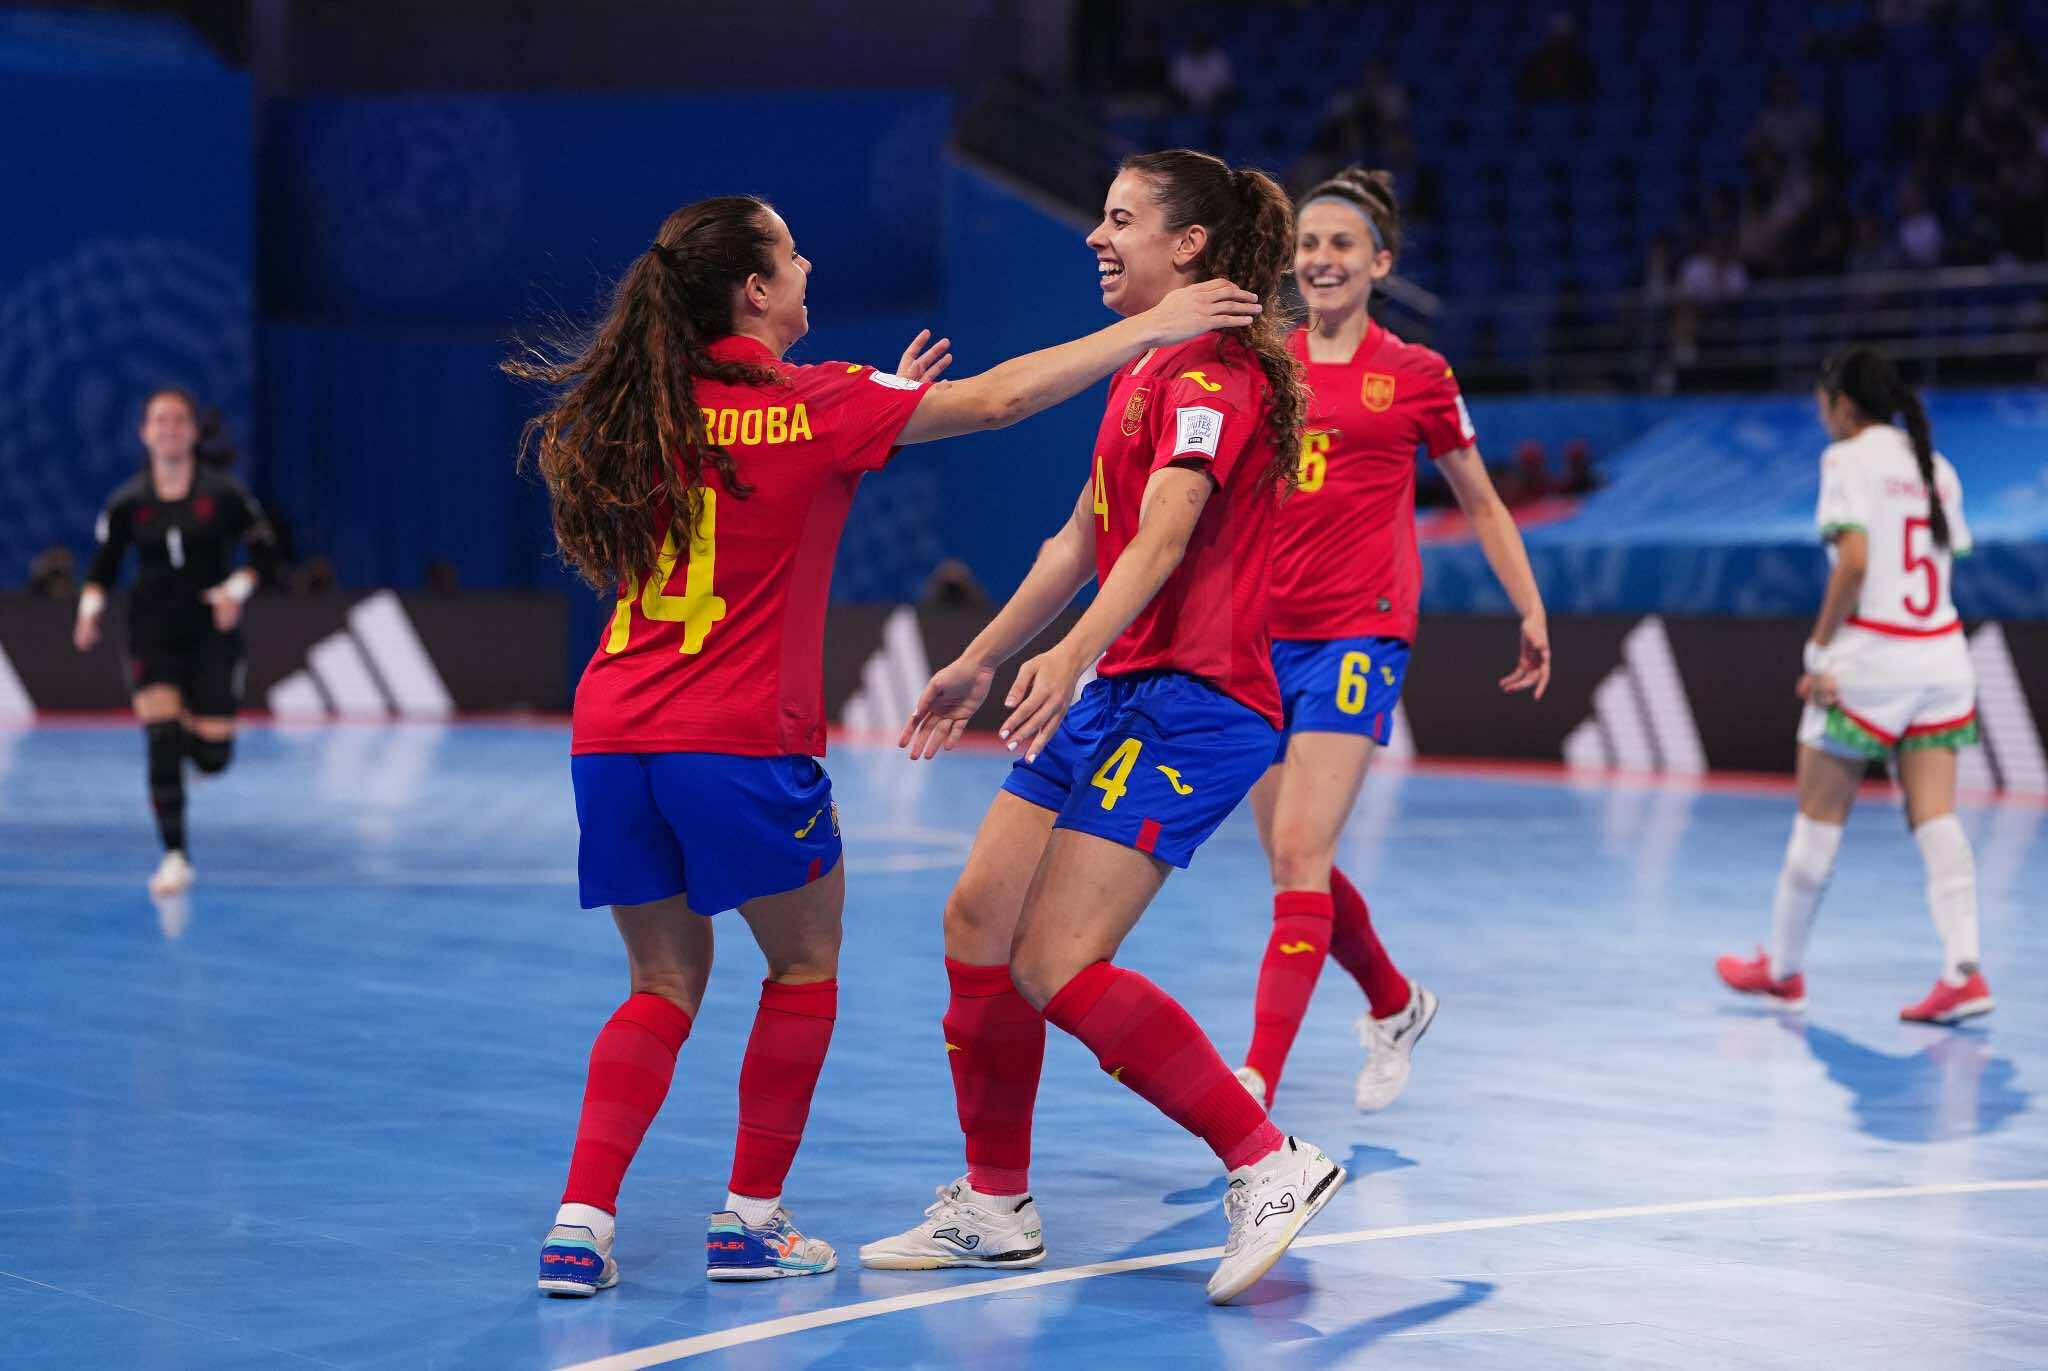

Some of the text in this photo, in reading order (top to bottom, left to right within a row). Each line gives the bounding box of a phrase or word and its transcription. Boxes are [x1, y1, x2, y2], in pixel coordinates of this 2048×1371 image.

[687, 403, 813, 446] RDOBA
[1094, 456, 1108, 532] 4
[1297, 432, 1330, 492] 6
[1903, 517, 1939, 617] 5
[1336, 651, 1371, 714] 6
[1090, 738, 1143, 811] 4
